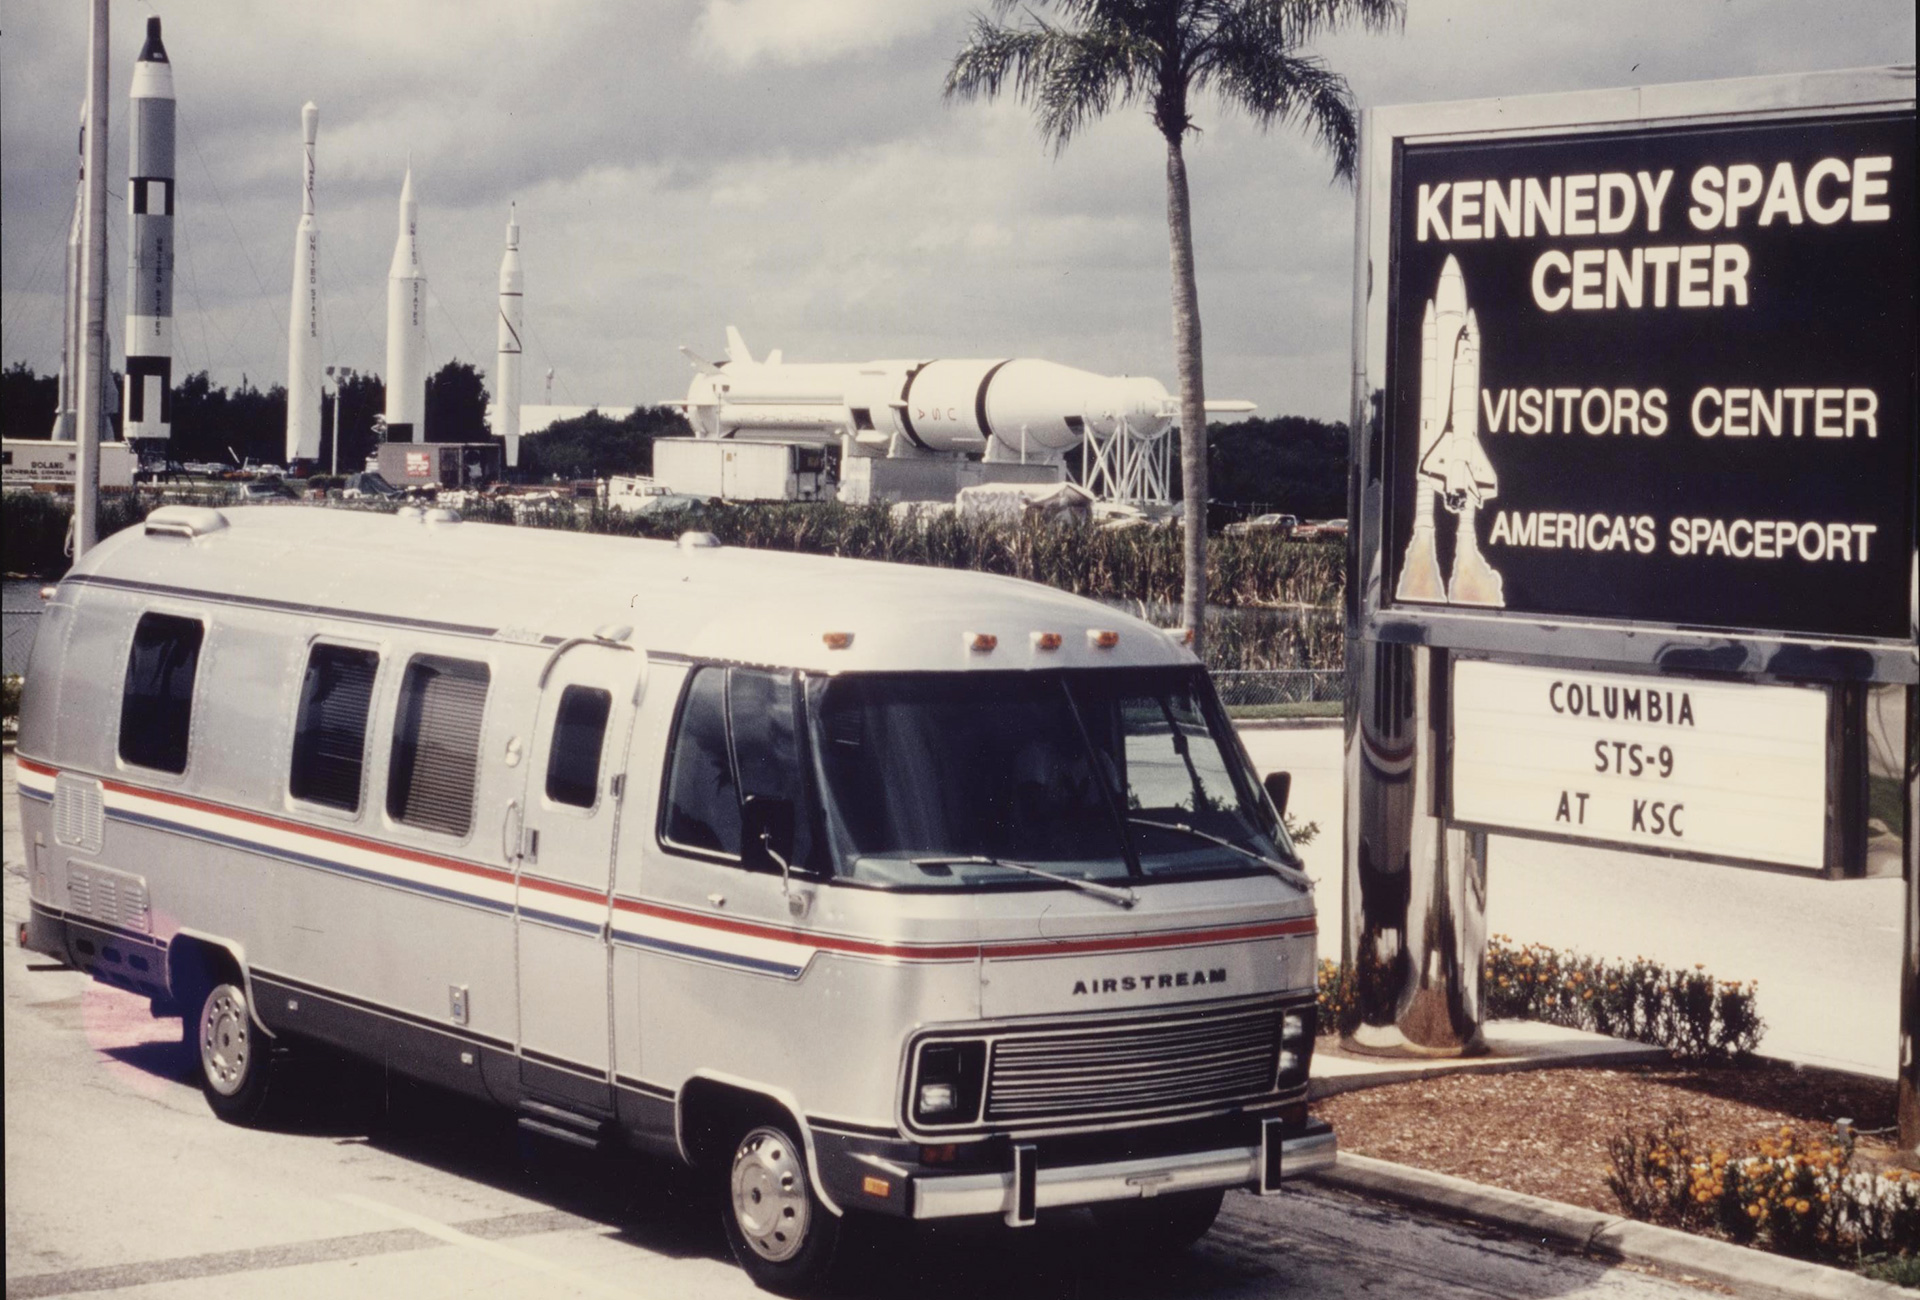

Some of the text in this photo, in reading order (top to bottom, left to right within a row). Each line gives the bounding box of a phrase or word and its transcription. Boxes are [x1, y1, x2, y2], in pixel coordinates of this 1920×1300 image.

[1416, 155, 1893, 242] KENNEDY SPACE
[410, 222, 418, 265] UNITED
[1531, 243, 1750, 312] CENTER
[1482, 386, 1879, 438] VISITORS CENTER
[1489, 510, 1877, 562] AMERICA'S SPACEPORT
[1549, 681, 1694, 726] COLUMBIA
[1595, 740, 1673, 778] STS-9
[1556, 791, 1685, 837] AT KSC
[1072, 967, 1227, 995] AIRSTREAM
